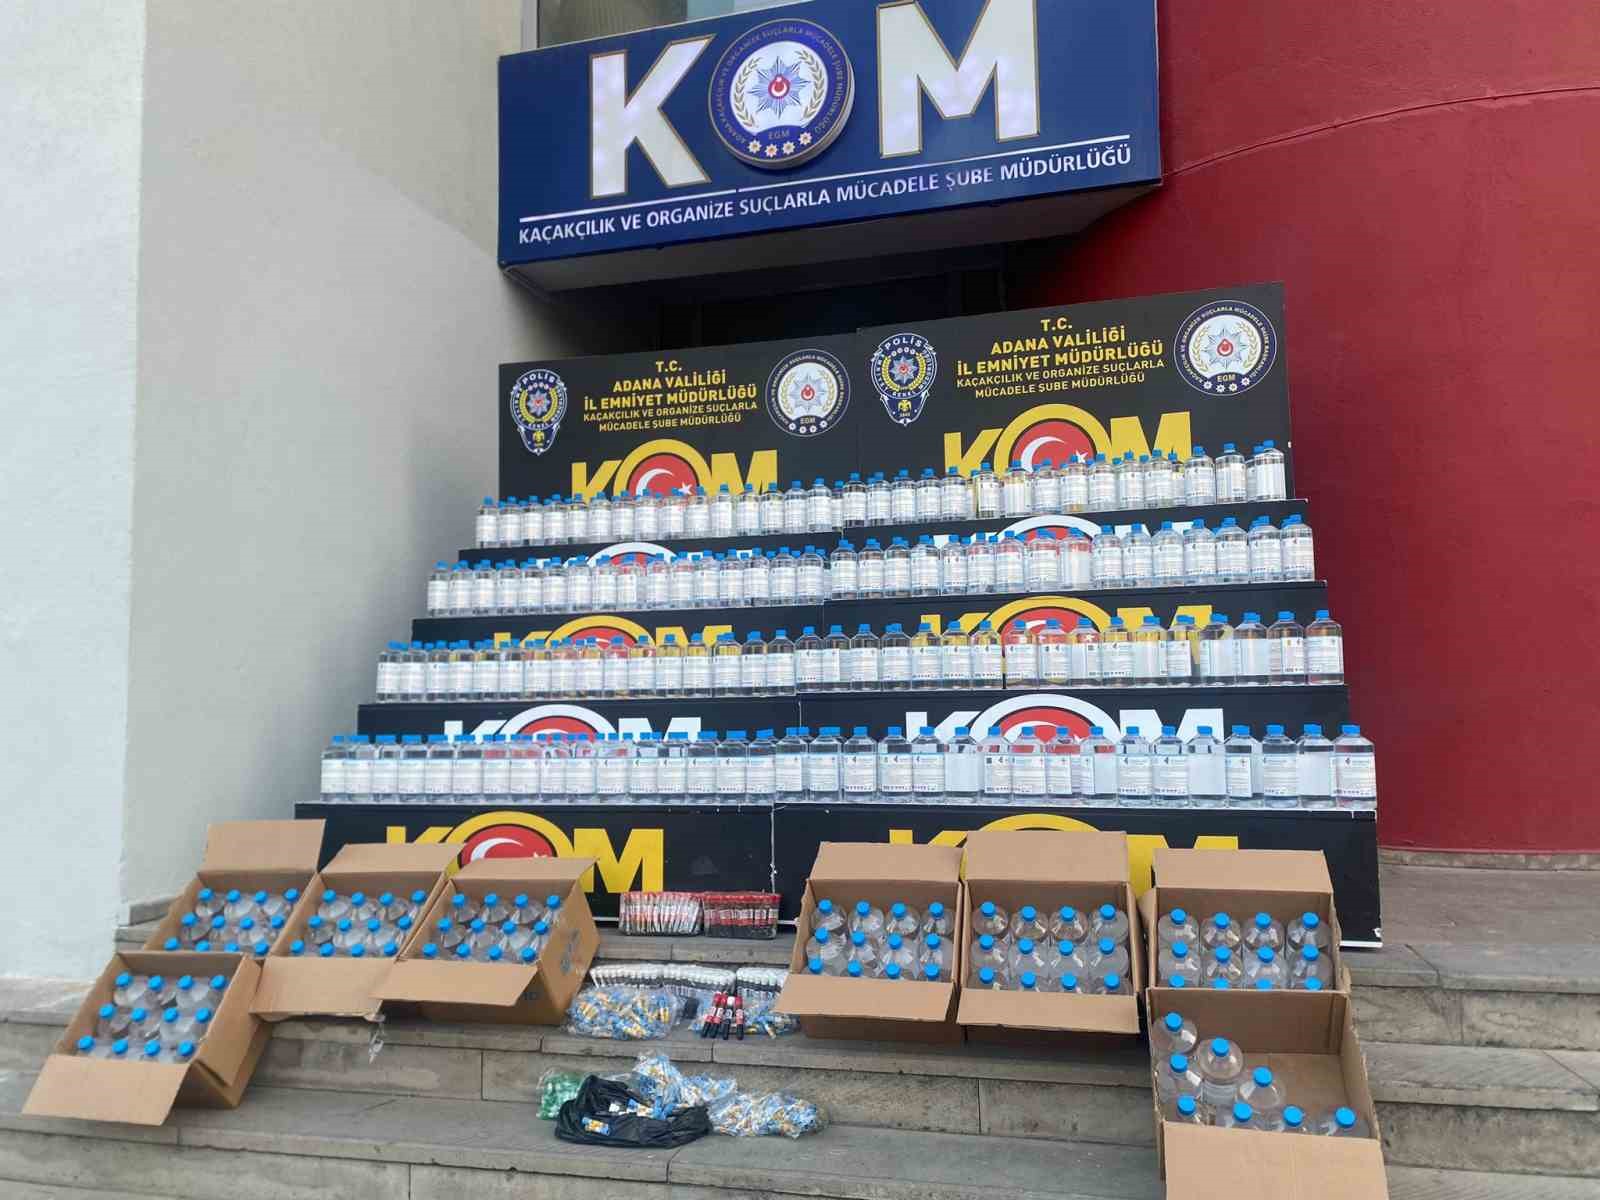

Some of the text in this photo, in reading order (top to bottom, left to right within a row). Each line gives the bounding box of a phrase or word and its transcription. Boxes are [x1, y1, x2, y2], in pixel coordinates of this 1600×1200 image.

[519, 143, 1131, 245] KAÇAKÇILIK VE ORGANİZE SUÇLARLA MÜCADELE ŞUBE MÜDÜRLÜĞÜ
[1040, 317, 1073, 333] T.C.
[885, 336, 922, 350] POLİS
[990, 325, 1126, 356] ADANA VALİLİĞİ
[655, 360, 683, 373] T.C.
[957, 341, 1164, 376] İL EMNİYET MÜDÜRLÜĞÜ
[613, 369, 727, 394] ADANA VALİLİĞİ
[956, 359, 1165, 389] KAÇAKÇILIK VE ORGANİZE SUÇLARLA
[975, 372, 1146, 398] MÜCADELE ŞUBE MÜDÜRLÜĞÜ
[1216, 373, 1236, 383] EGM
[584, 395, 598, 411] İL
[601, 390, 663, 409] EMNİYET
[666, 383, 757, 405] MÜDÜRLÜĞÜ
[583, 401, 757, 424] KAÇAKÇILIK VE ORGANİZE SUÇLARLA
[599, 413, 741, 432] MÜCADELE ŞUBE MÜDÜRLÜĞÜ
